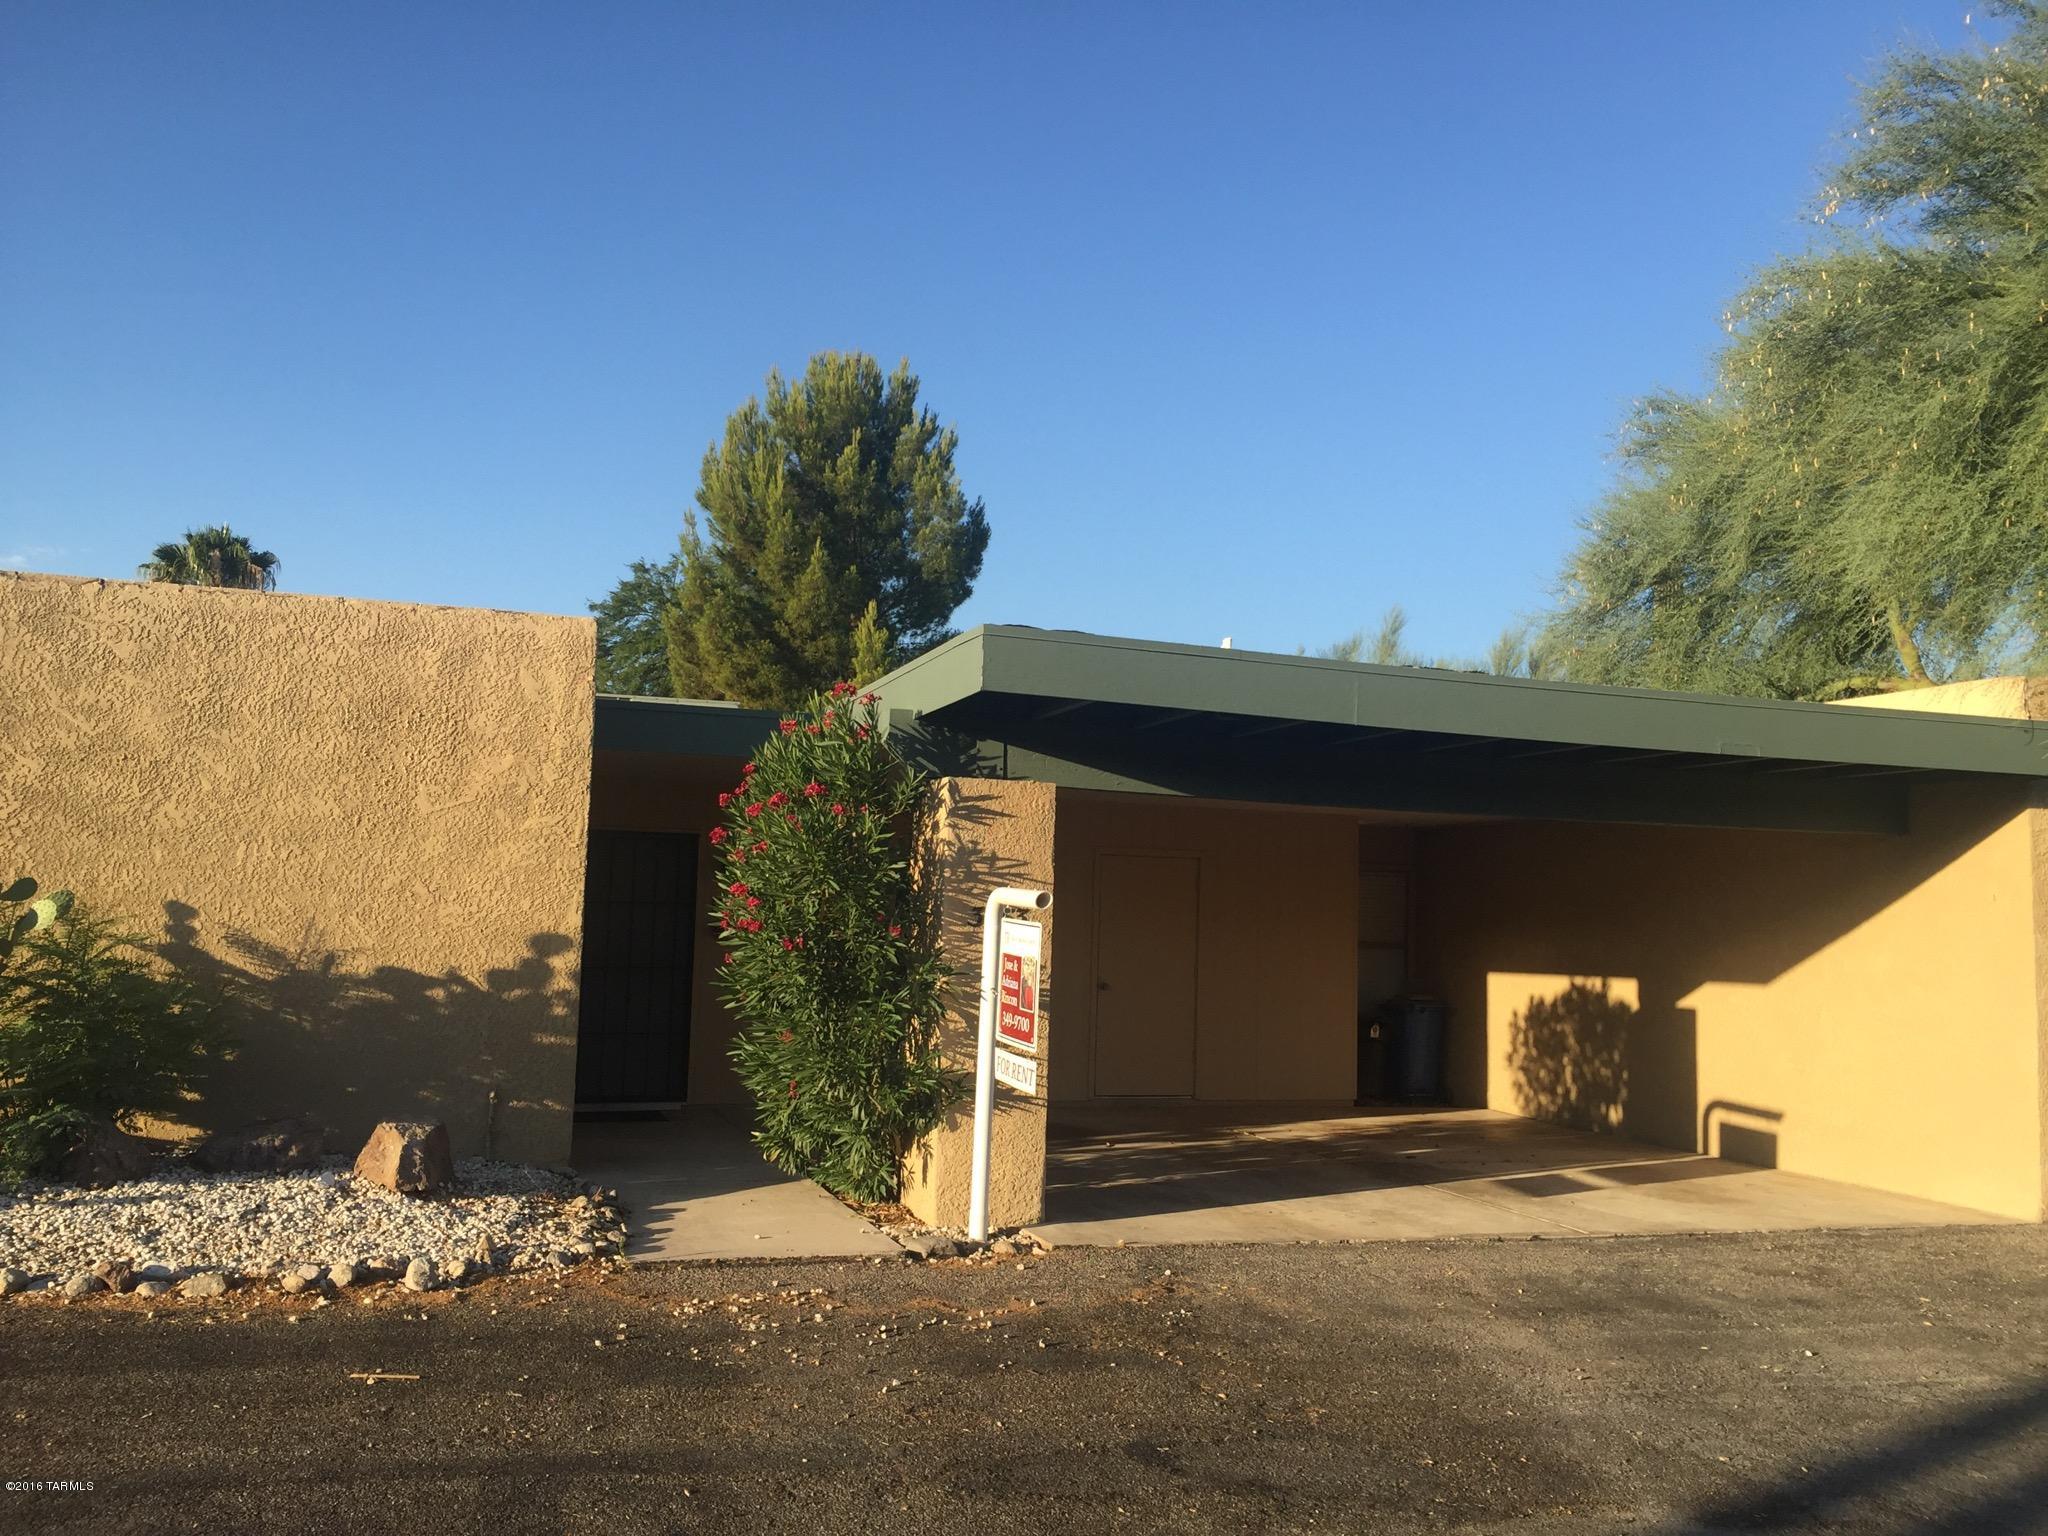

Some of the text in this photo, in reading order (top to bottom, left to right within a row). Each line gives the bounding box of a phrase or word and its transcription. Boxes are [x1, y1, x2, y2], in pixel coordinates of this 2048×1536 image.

[1001, 1011, 1030, 1032] 349-9700
[997, 1056, 1035, 1086] FOR RENT
